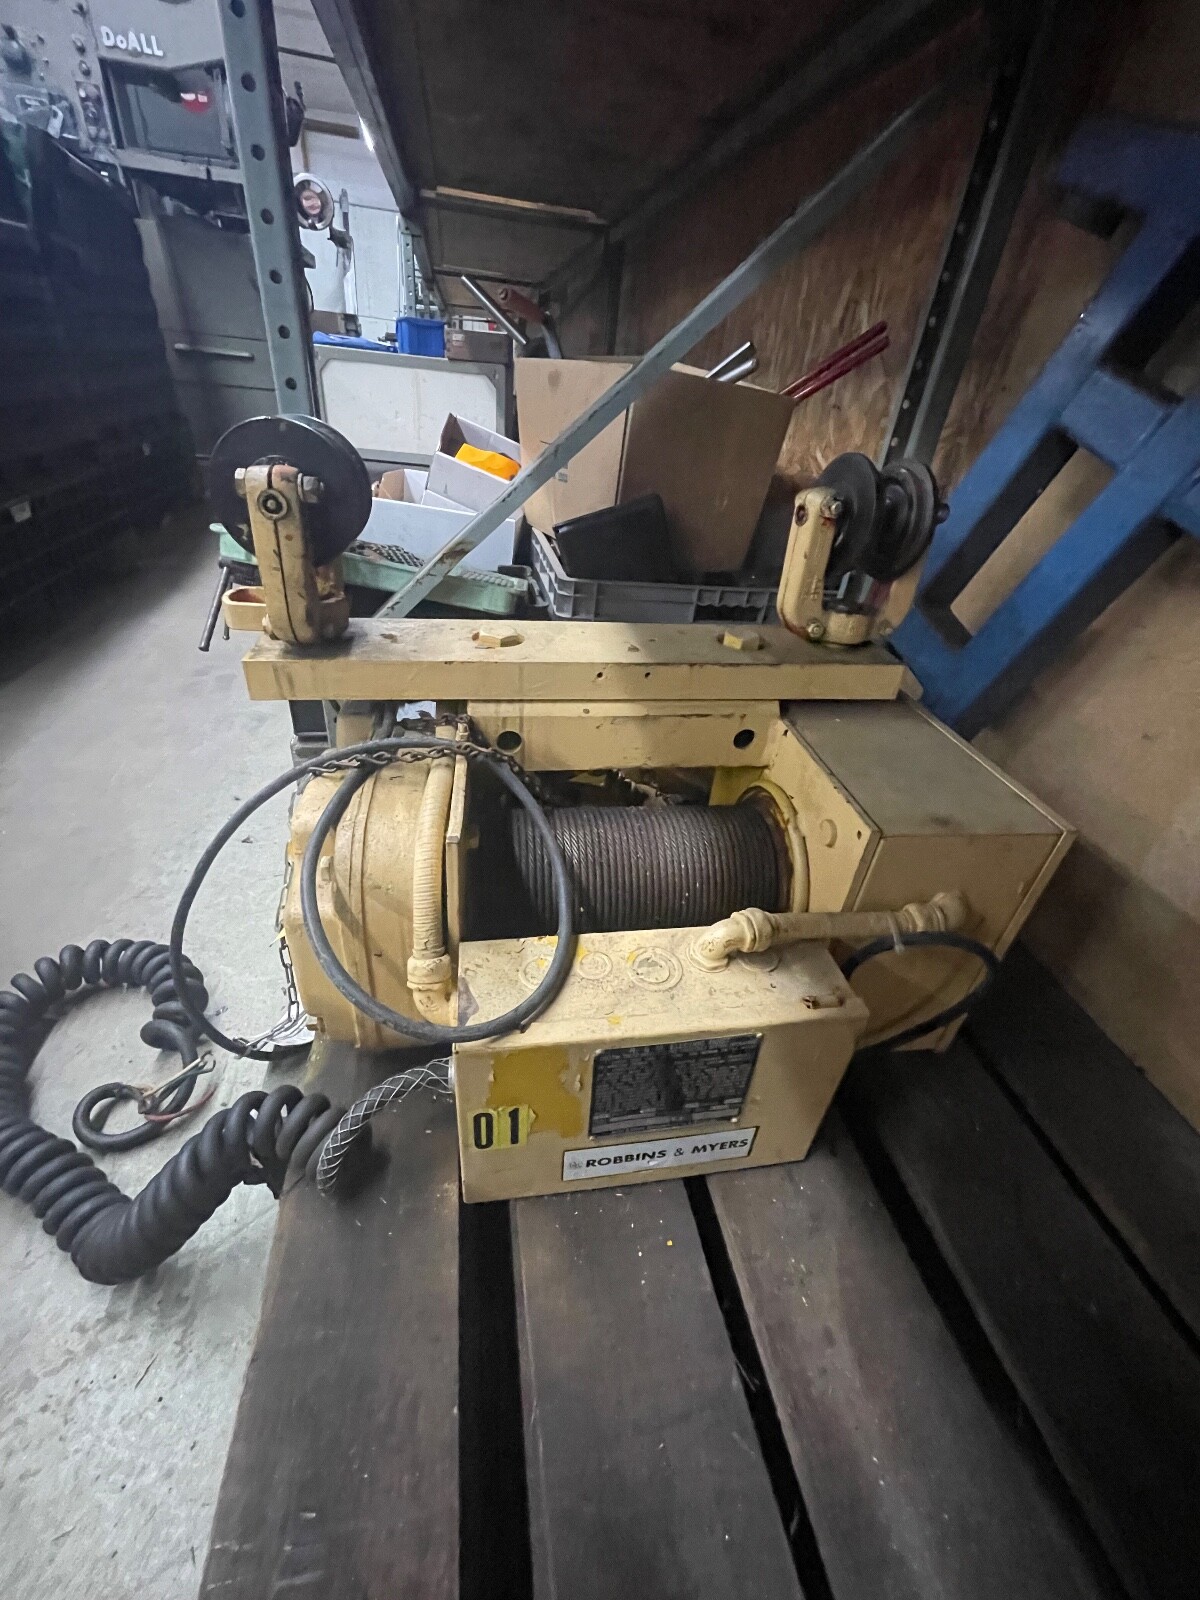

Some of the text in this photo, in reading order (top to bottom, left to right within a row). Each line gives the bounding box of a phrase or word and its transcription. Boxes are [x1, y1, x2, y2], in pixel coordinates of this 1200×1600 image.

[100, 25, 164, 57] DoALL
[473, 1107, 520, 1150] 01
[585, 1149, 667, 1168] ROBBINS
[673, 1147, 685, 1157] &
[690, 1138, 749, 1155] MYERS
